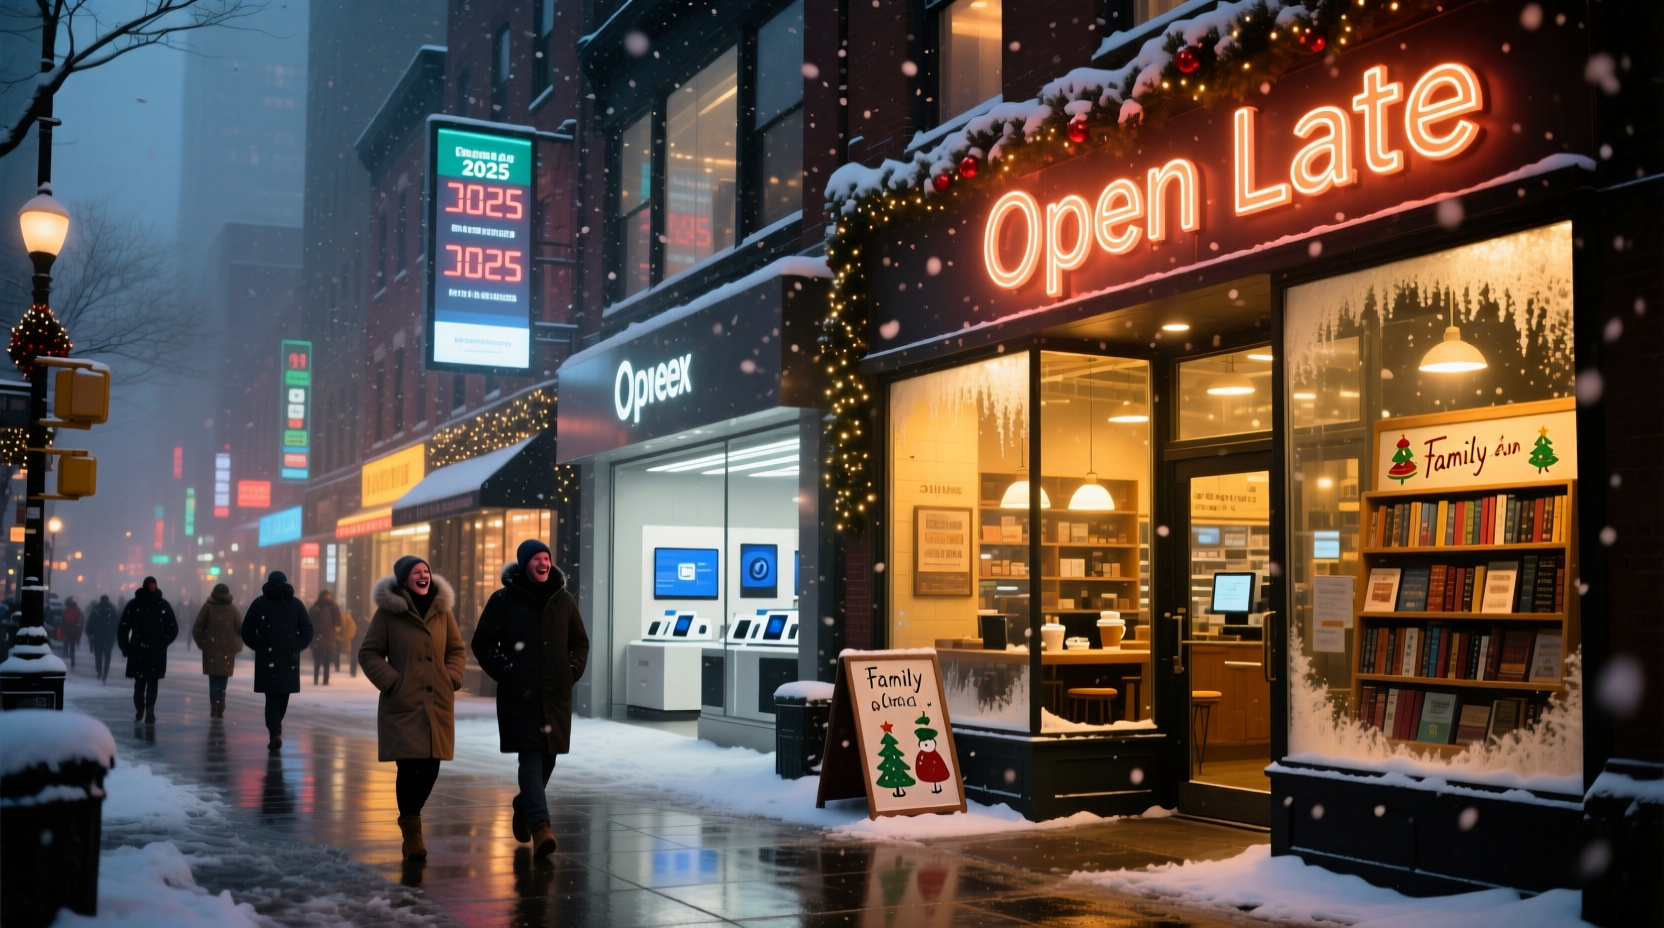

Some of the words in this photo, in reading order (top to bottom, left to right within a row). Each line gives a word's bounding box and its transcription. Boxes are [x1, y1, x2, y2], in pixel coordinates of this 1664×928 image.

[461, 159, 510, 181] 2025
[983, 157, 1201, 298] Open
[1233, 62, 1485, 218] Late
[1424, 435, 1487, 478] Family
[865, 666, 922, 693] Family
